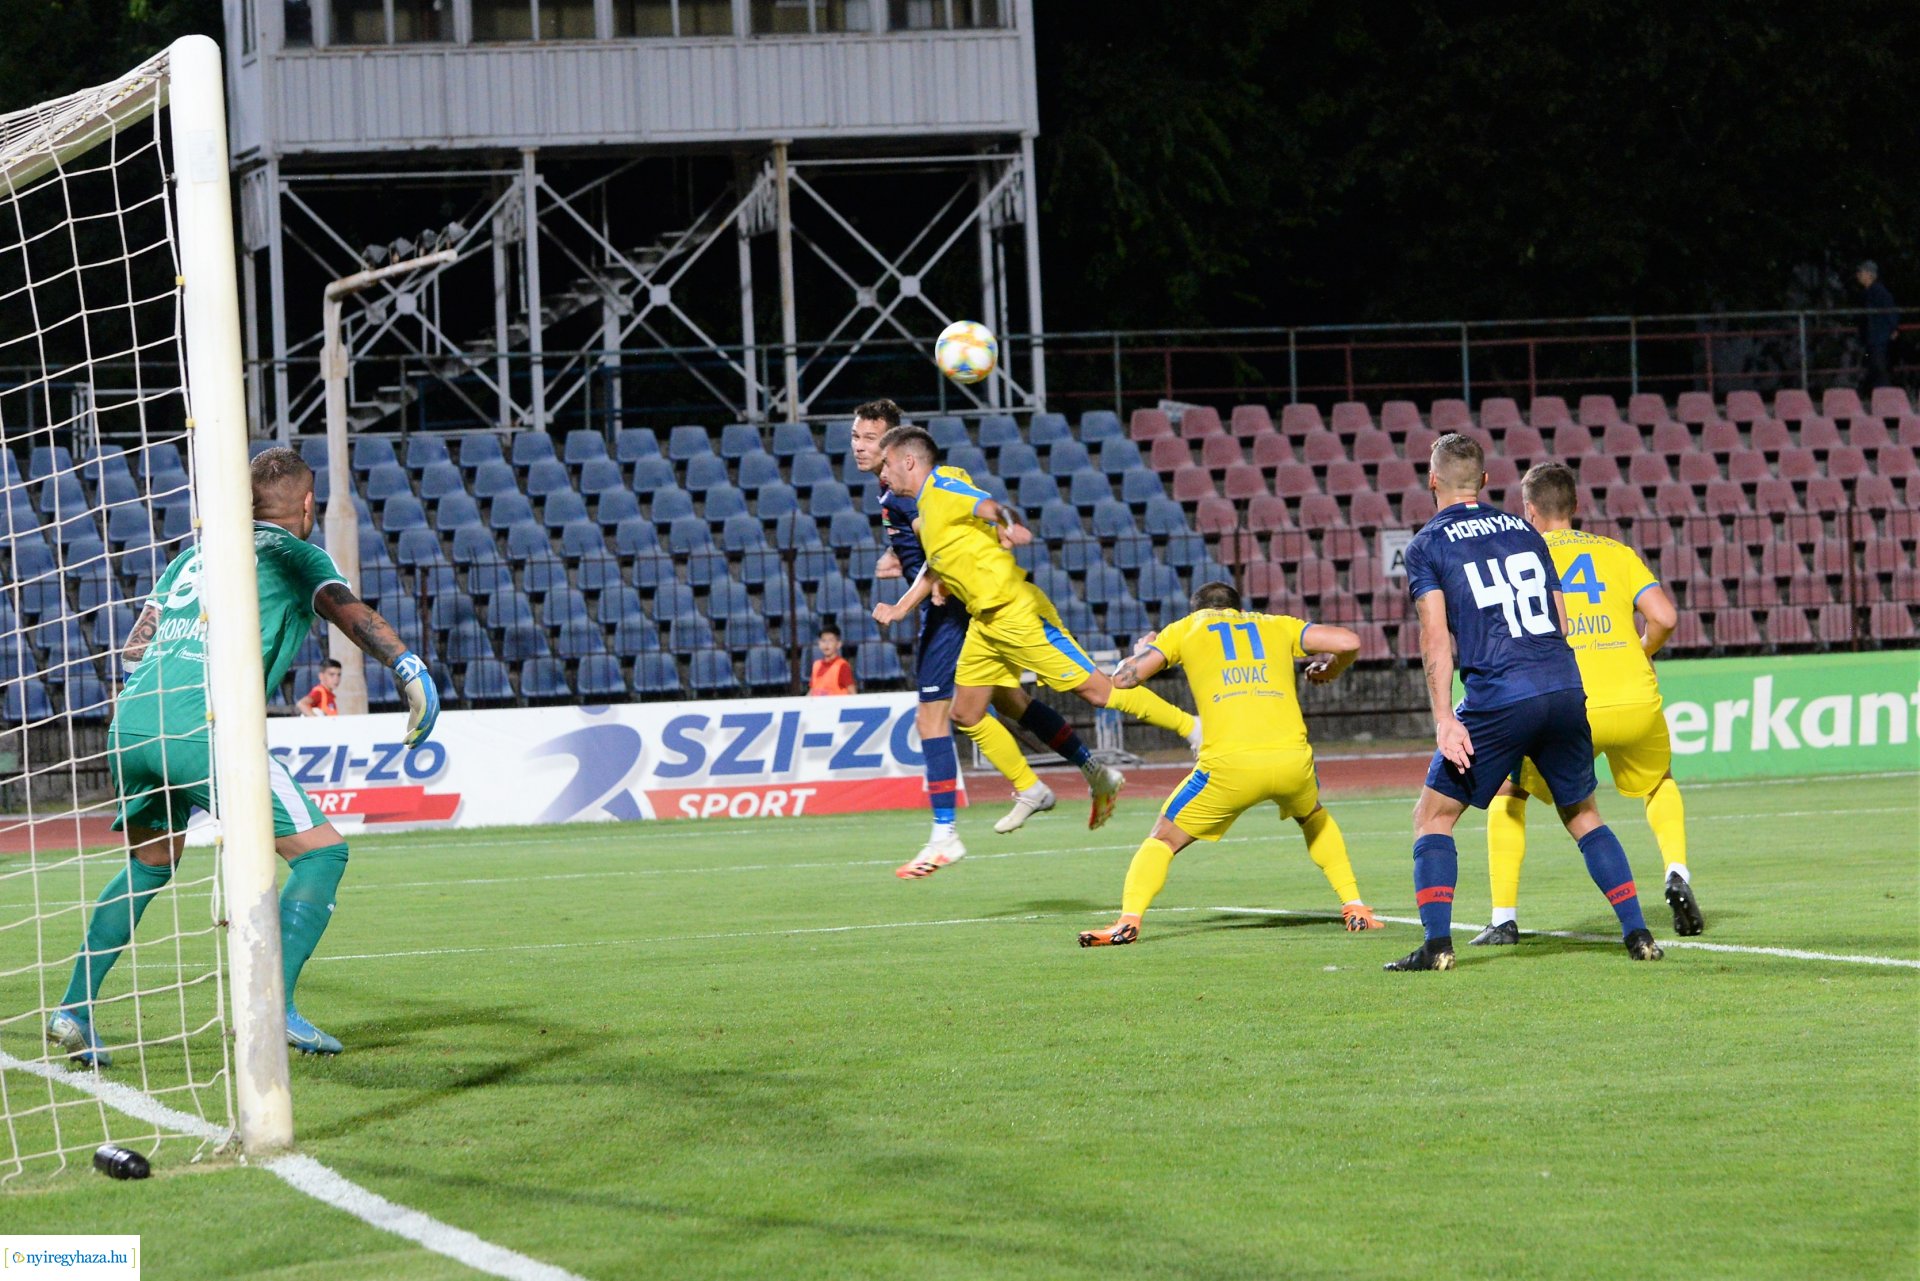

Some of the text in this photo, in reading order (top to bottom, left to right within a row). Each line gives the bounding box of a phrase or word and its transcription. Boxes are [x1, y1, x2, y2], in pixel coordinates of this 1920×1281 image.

[1463, 551, 1556, 638] 48
[1560, 553, 1606, 604] 4
[1207, 621, 1265, 661] 11
[1567, 613, 1611, 637] DÁVID
[1222, 663, 1269, 686] KOVAČ
[677, 788, 817, 819] SPORT
